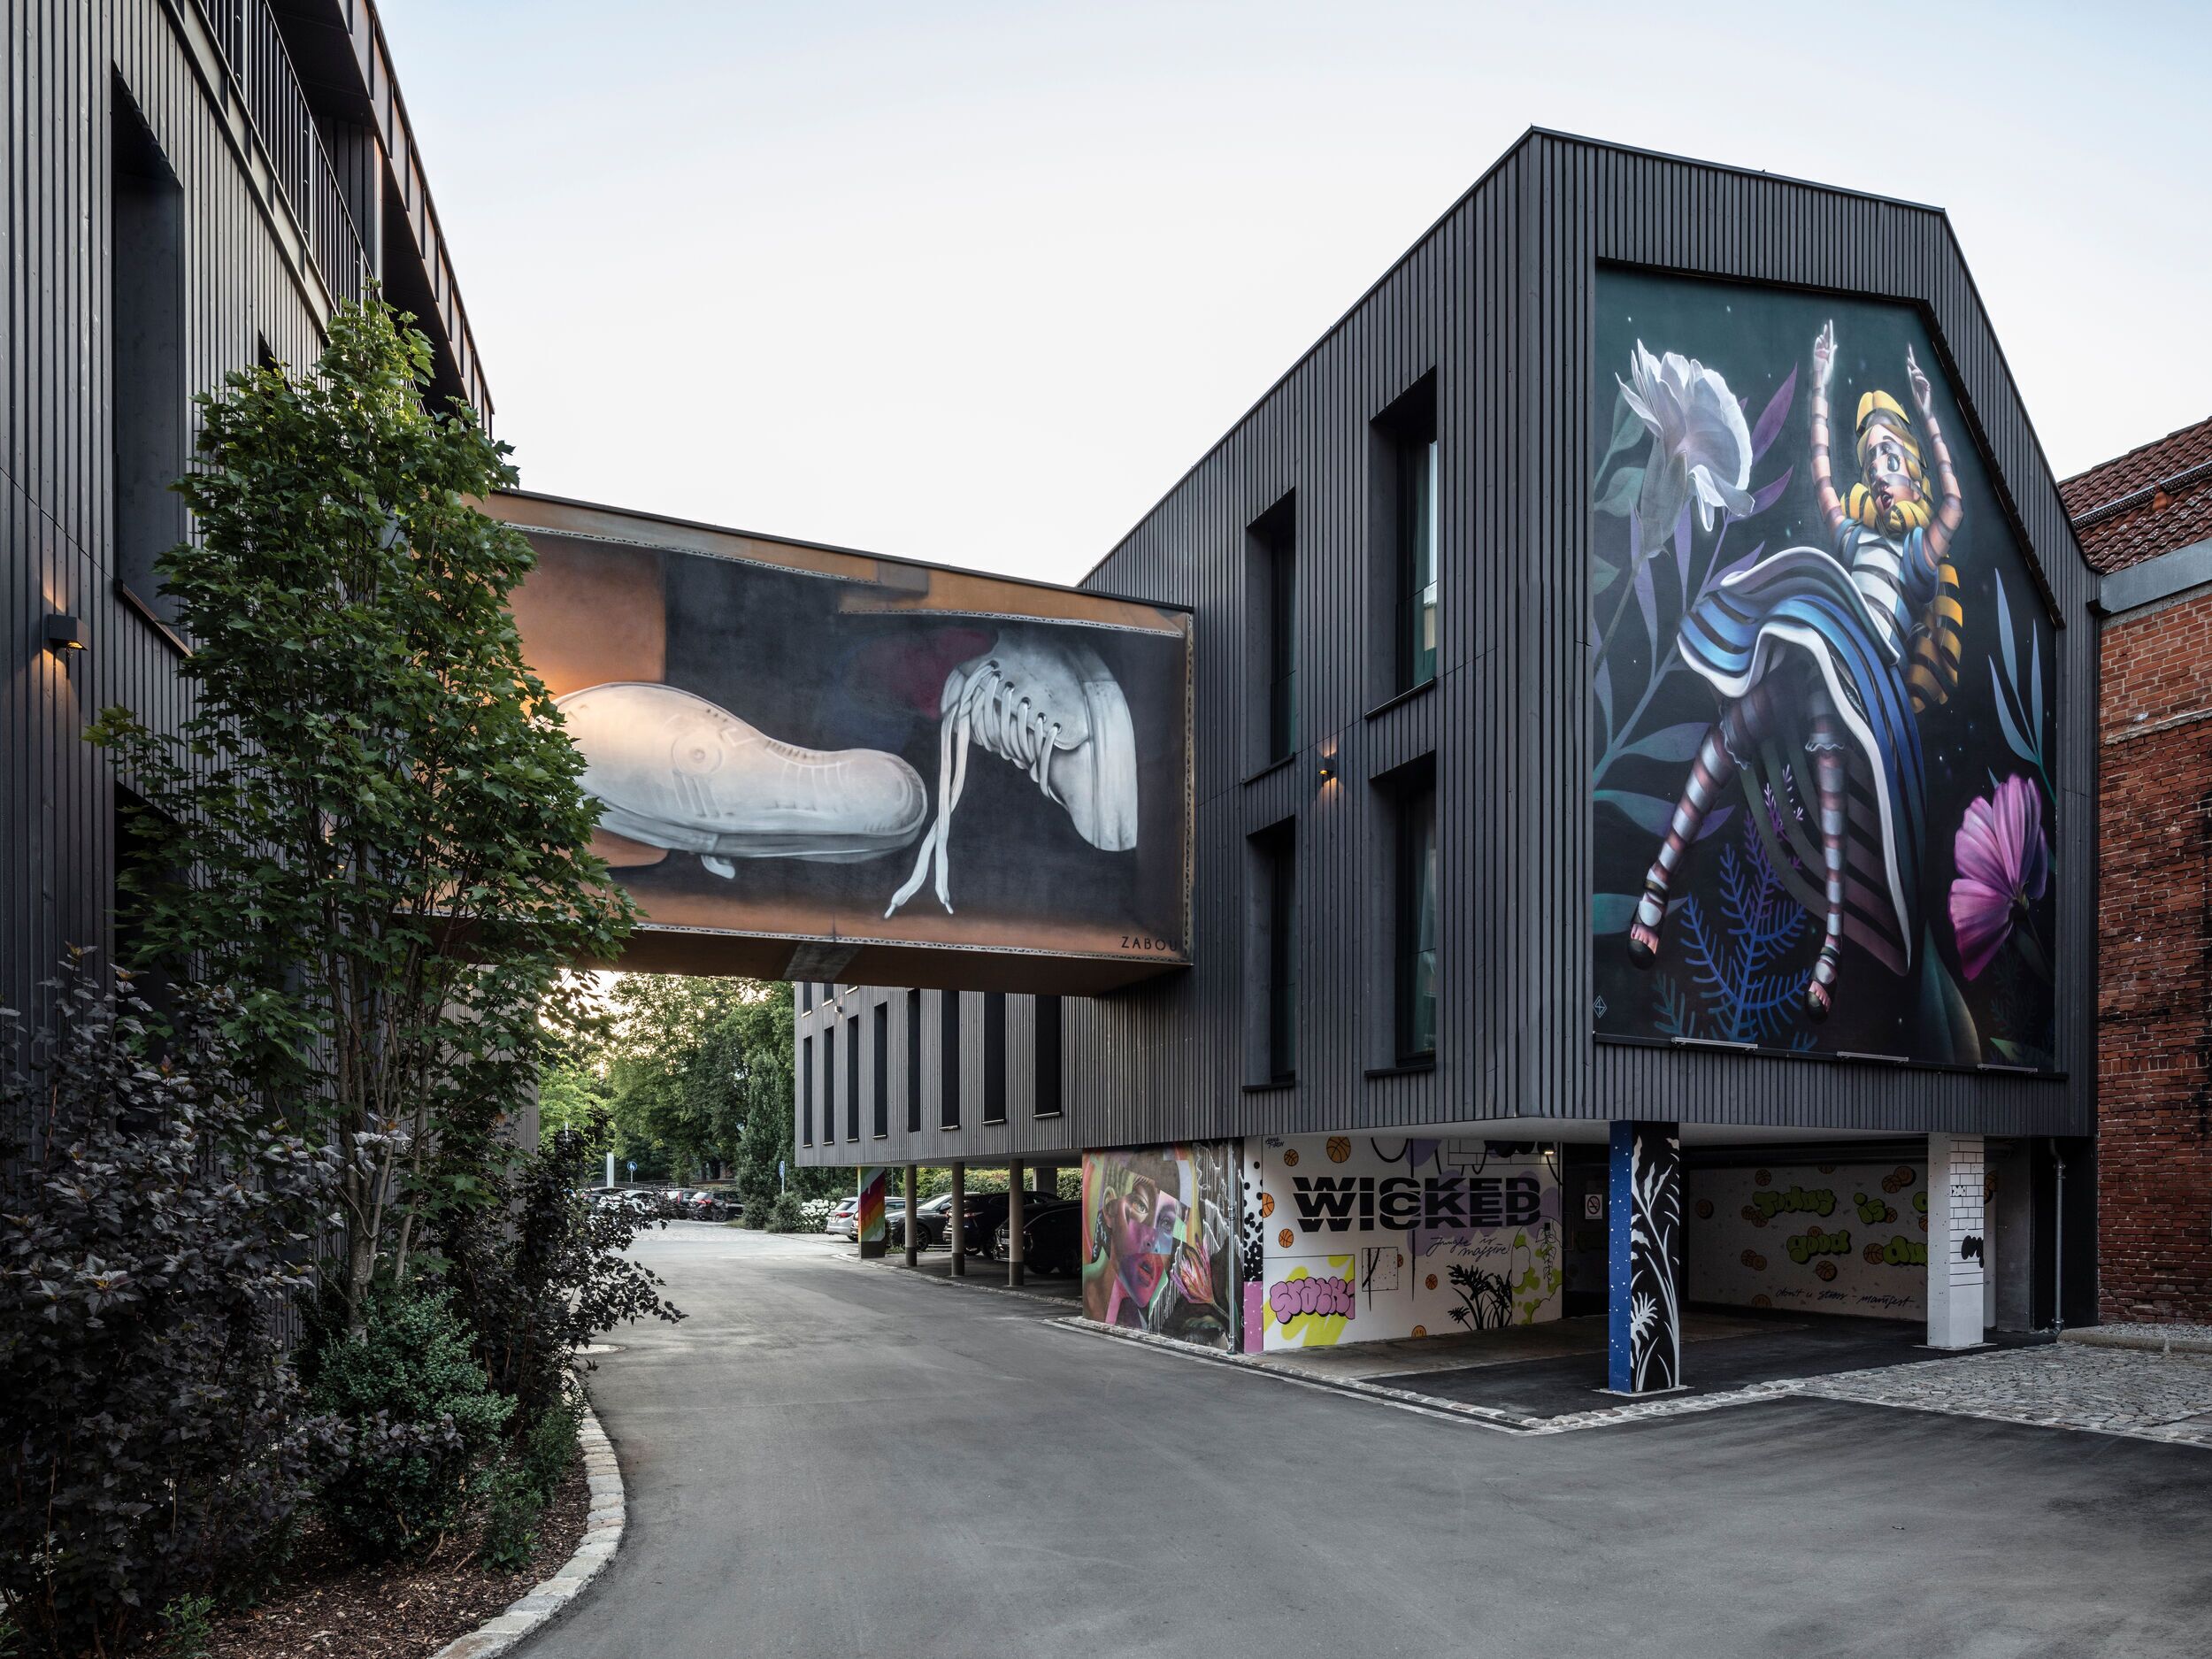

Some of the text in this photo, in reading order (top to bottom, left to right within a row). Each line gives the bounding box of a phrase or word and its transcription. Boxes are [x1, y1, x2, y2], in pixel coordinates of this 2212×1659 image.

[1121, 936, 1178, 952] ZABOU
[1854, 1192, 1886, 1225] is
[1426, 1235, 1497, 1257] Jungle is
[1786, 1229, 1928, 1265] good da
